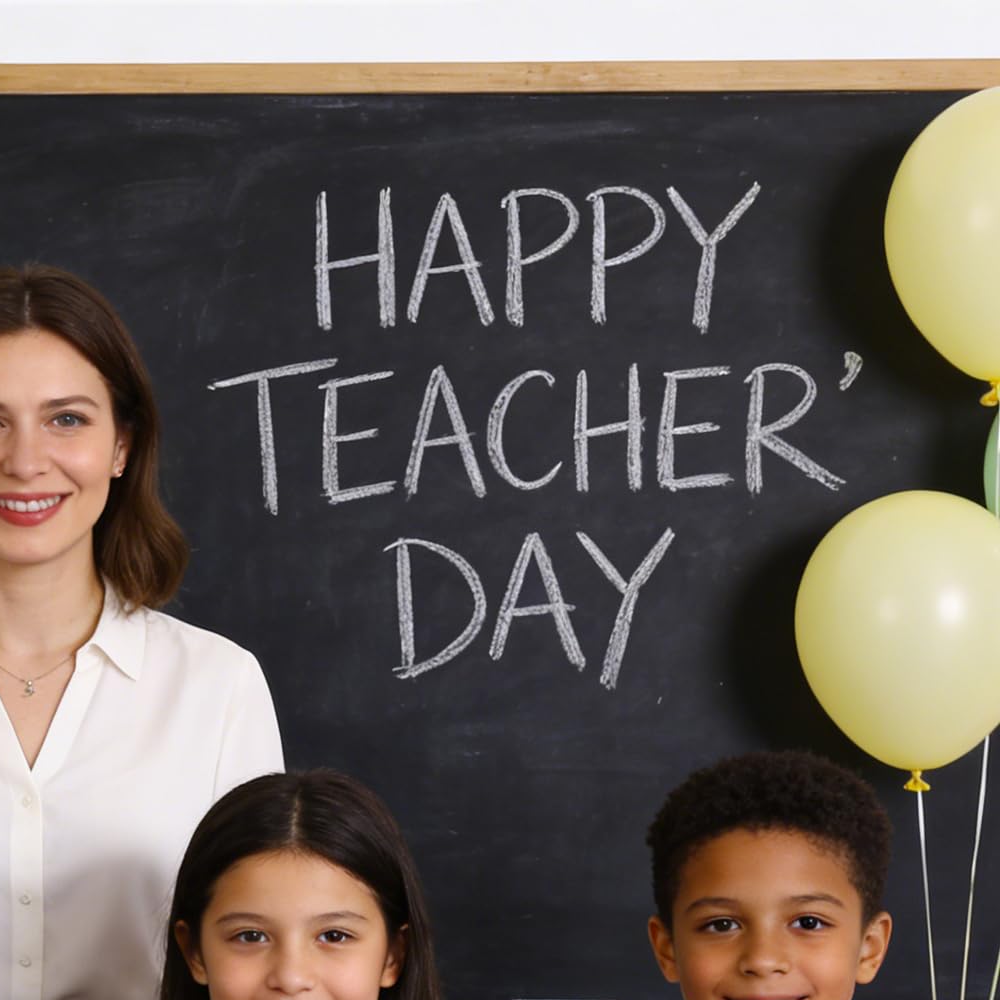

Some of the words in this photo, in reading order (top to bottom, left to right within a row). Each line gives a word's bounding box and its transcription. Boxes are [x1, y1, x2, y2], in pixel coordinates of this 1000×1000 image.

[313, 180, 762, 335] HAPPY
[206, 350, 864, 517] TEACHER'
[382, 526, 677, 691] DAY
